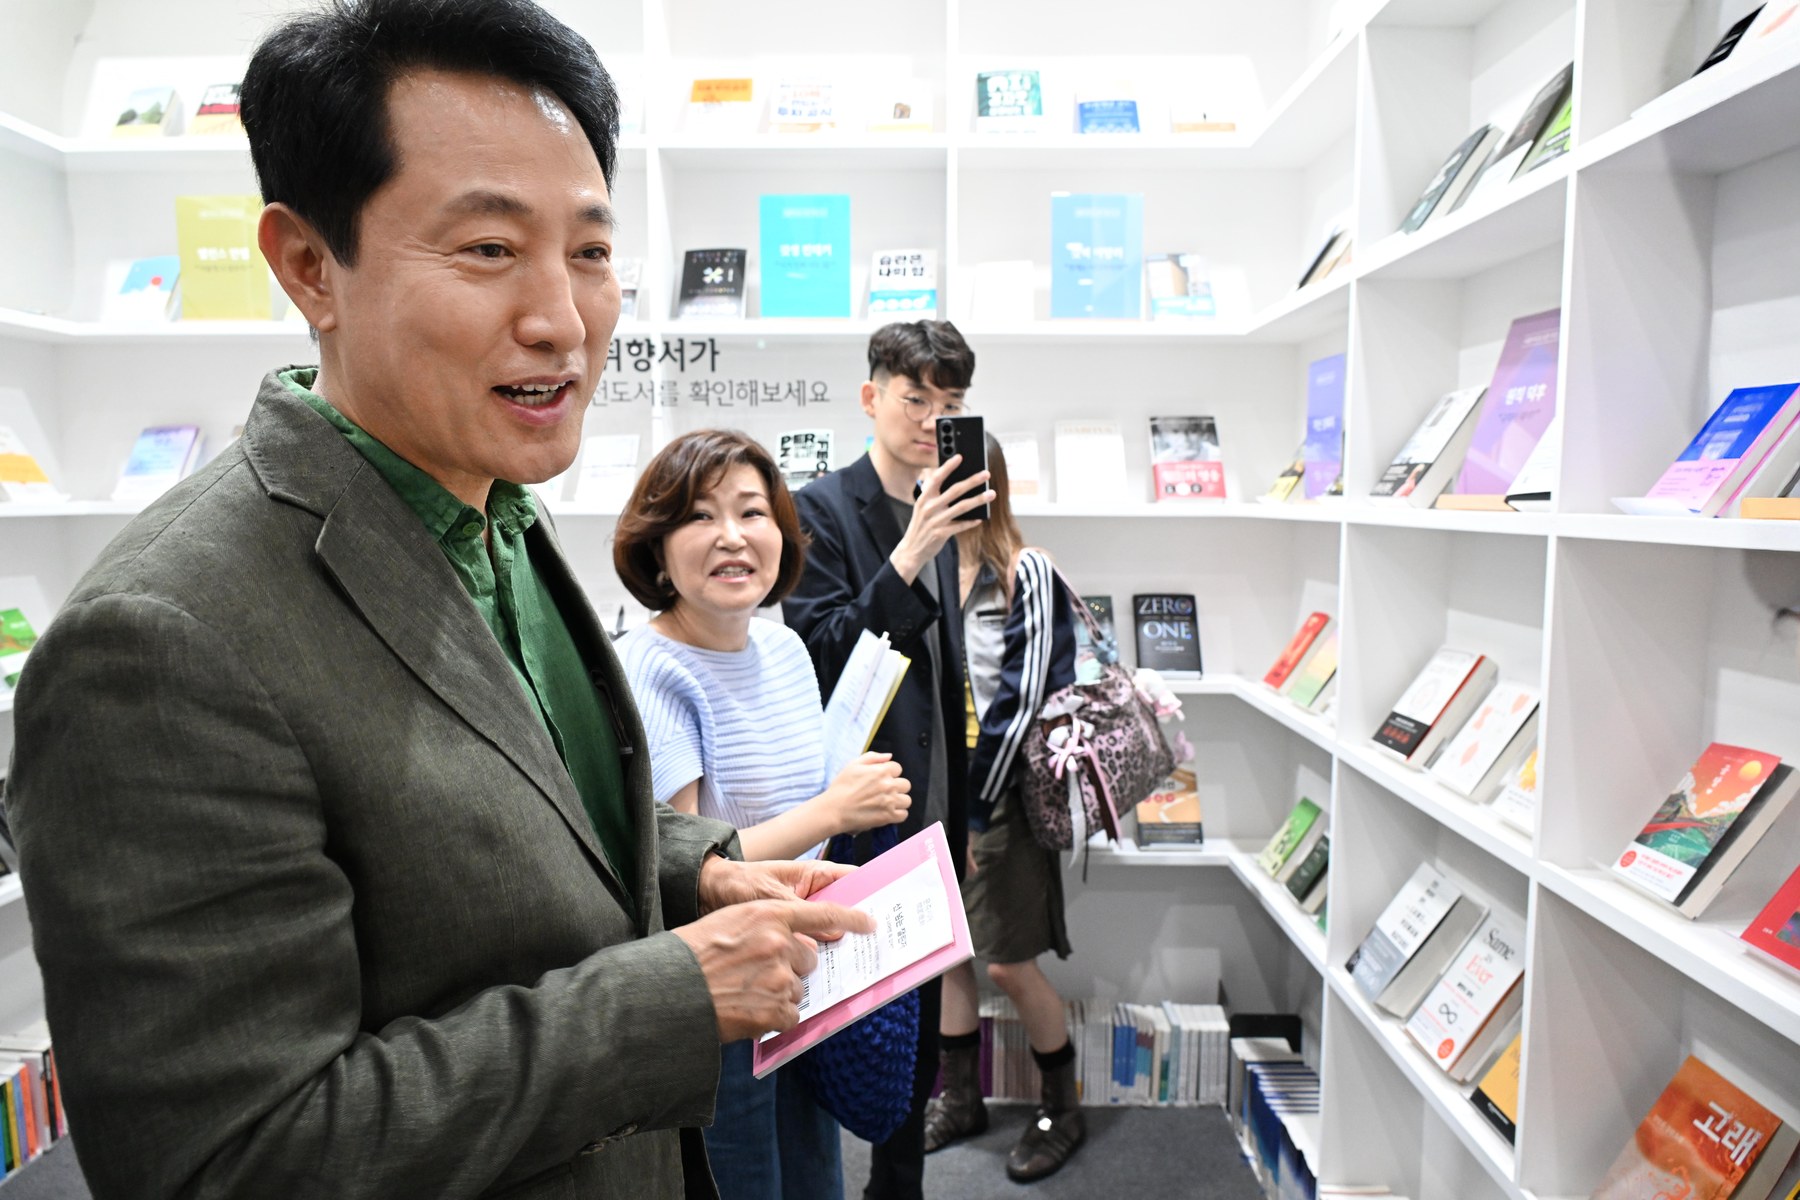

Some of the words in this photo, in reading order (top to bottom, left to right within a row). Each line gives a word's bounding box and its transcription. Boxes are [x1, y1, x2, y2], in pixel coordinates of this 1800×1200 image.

[880, 254, 922, 265] 습관은
[879, 267, 906, 277] 나의
[689, 379, 830, 407] 확인해보세요
[1138, 597, 1193, 615] ZERO
[1143, 620, 1193, 640] ONE
[1485, 927, 1515, 961] Same
[1692, 1101, 1763, 1166] 고래
